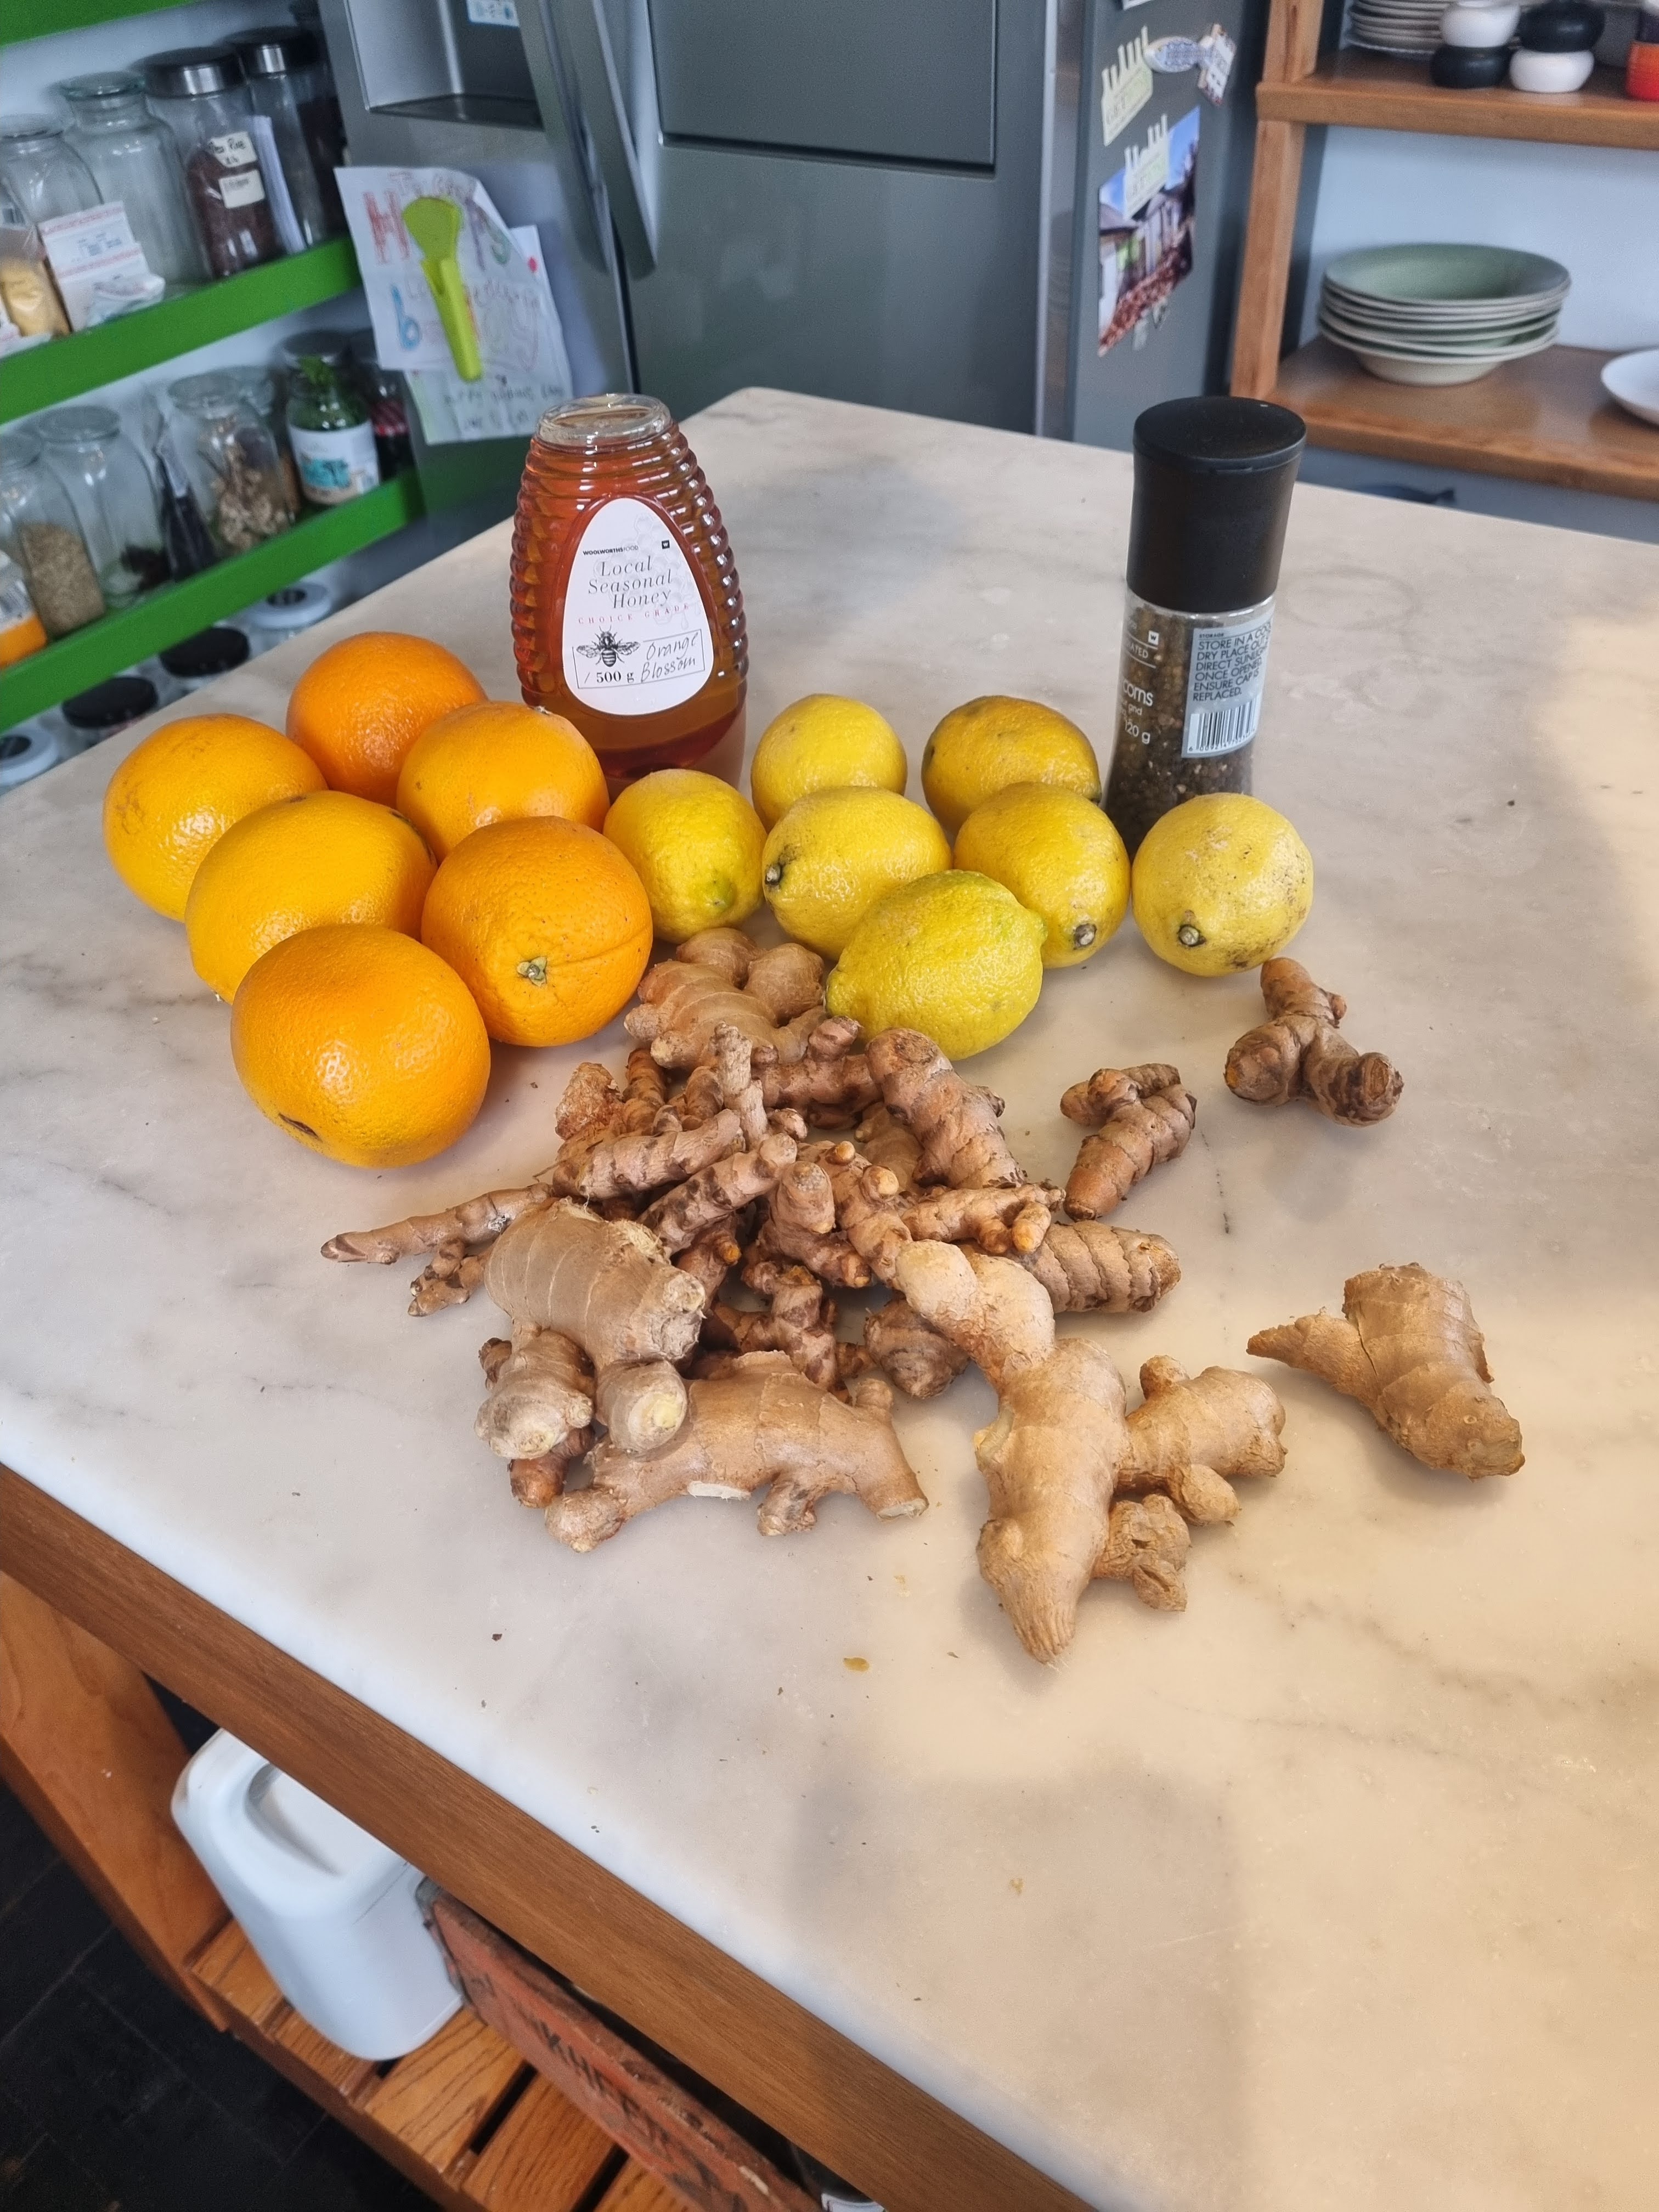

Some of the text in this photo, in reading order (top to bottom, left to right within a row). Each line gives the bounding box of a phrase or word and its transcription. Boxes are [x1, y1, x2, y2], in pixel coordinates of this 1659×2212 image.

[601, 555, 652, 576] Local
[588, 569, 672, 594] Seasonal
[613, 590, 671, 608] Honey
[578, 604, 690, 624] CHOICE GRADE
[646, 631, 698, 661] Orange
[1198, 639, 1232, 650] STORE
[1234, 635, 1245, 646] IN
[1246, 633, 1252, 642] A
[1197, 651, 1217, 661] DRY
[1221, 644, 1249, 659] PLACE
[641, 657, 696, 684] Blossom
[1196, 659, 1232, 671] DIRECT
[596, 671, 635, 684] 500 g
[1194, 679, 1233, 691] ENSURE
[1235, 672, 1252, 685] CAP
[1195, 670, 1228, 681] ONCE
[1193, 687, 1242, 701] REPLACED.
[1142, 732, 1150, 744] g
